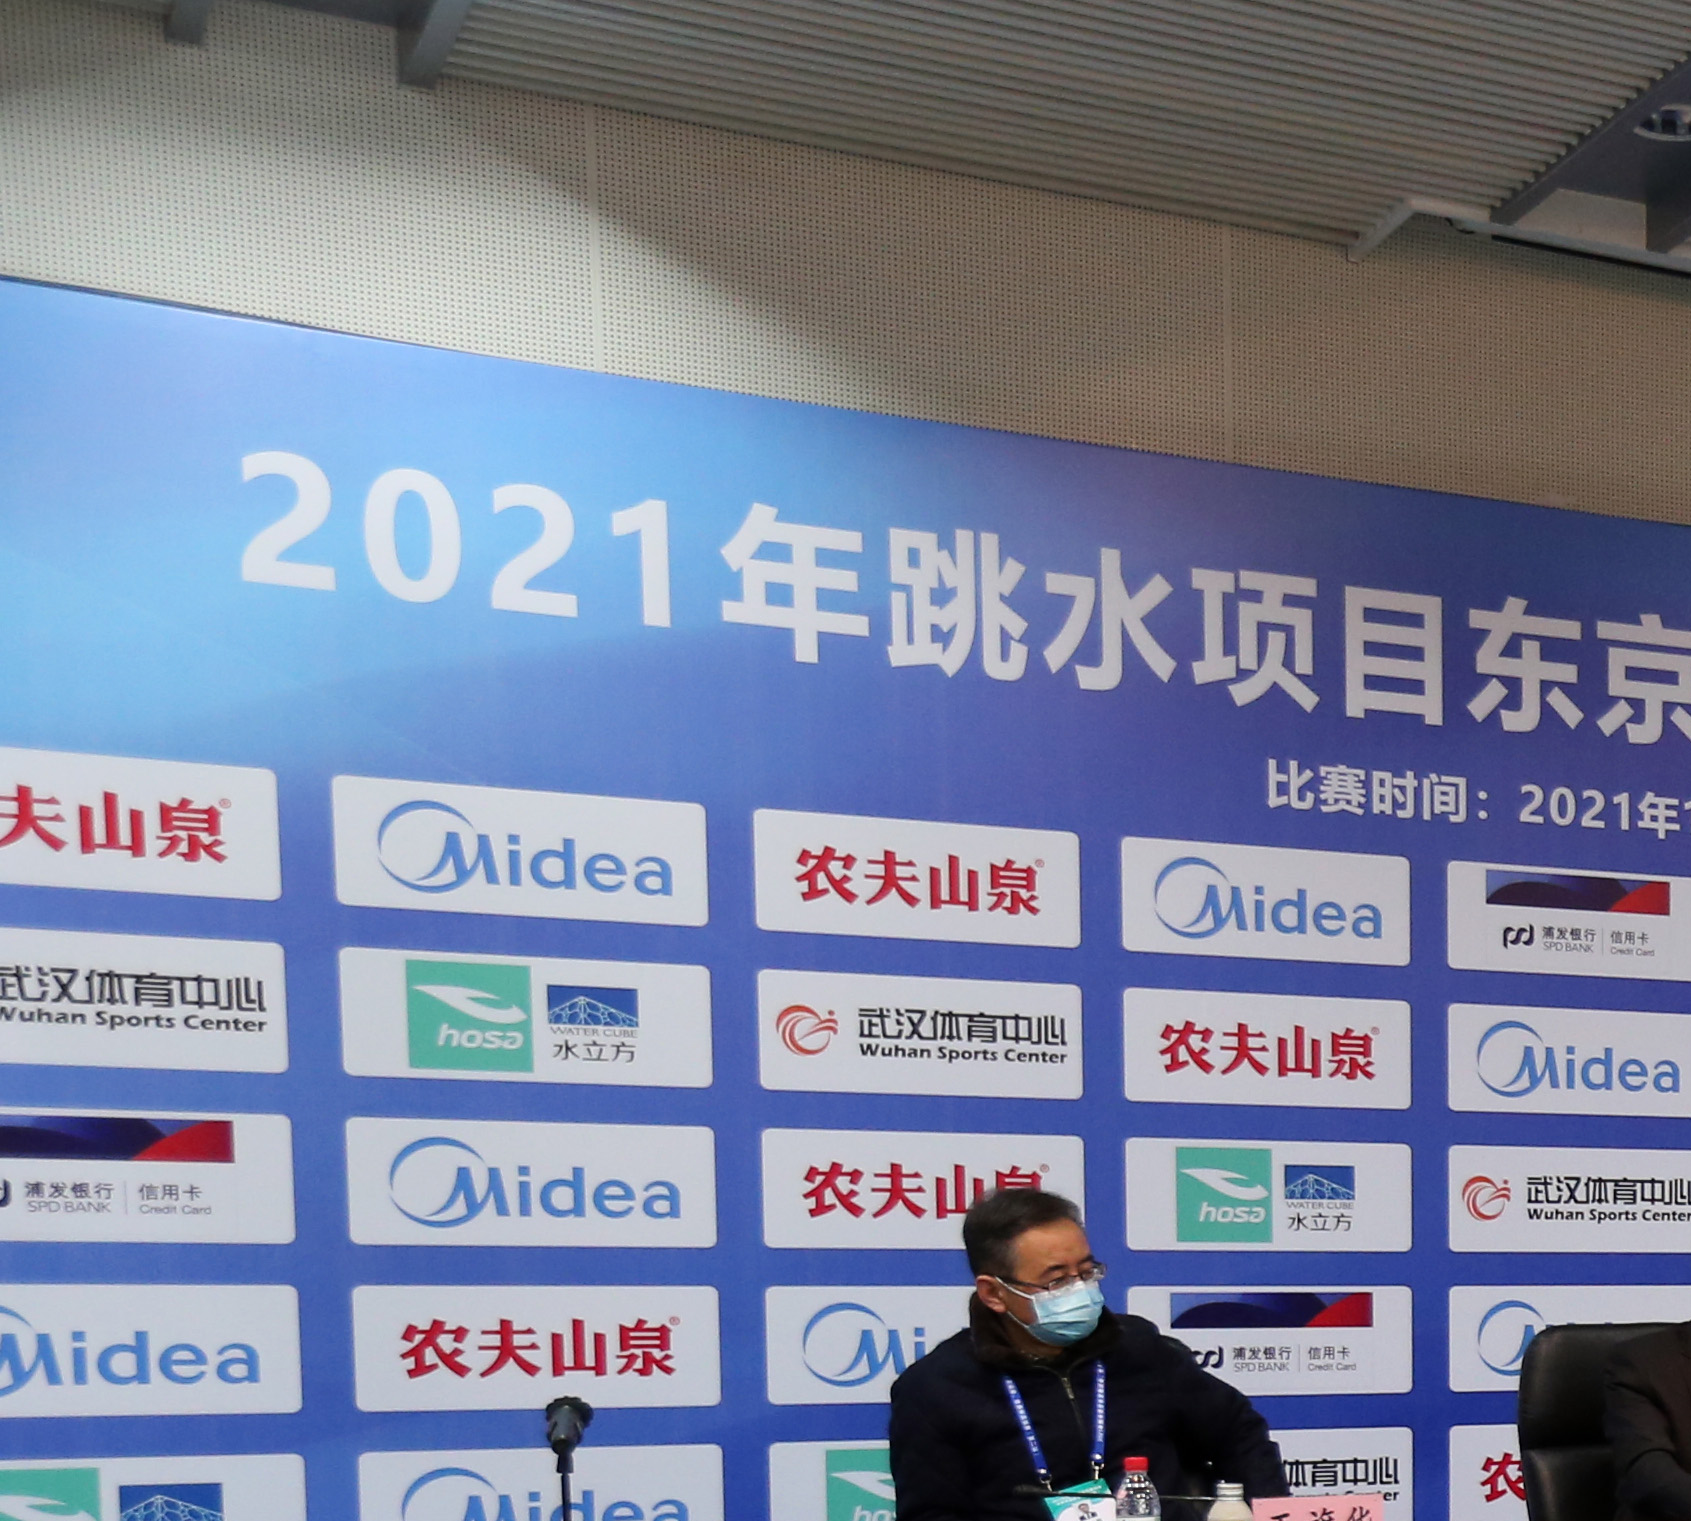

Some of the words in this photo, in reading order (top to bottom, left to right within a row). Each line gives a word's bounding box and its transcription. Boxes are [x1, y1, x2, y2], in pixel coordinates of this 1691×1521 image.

[377, 799, 674, 897] Midea
[795, 845, 1041, 917] 农夫山泉
[1154, 856, 1384, 939] Midea
[1542, 926, 1597, 943] 浦发银行
[1611, 931, 1650, 946] 信用卡
[1543, 941, 1563, 951] SPD
[1565, 943, 1594, 953] BANK
[0, 965, 267, 1012] 武汉体育中心
[95, 1010, 176, 1031] Sports
[184, 1014, 268, 1032] Center
[858, 1007, 1068, 1048] 武汉体育中心
[437, 1022, 525, 1051] hosa
[550, 1026, 607, 1037] WATER
[609, 1028, 639, 1039] CUBE
[553, 1039, 637, 1064] 水立方
[859, 1043, 932, 1062] Wuhan
[937, 1046, 999, 1065] Sports
[1004, 1048, 1068, 1065] Center
[1159, 1020, 1376, 1082] 农夫山泉
[1476, 1020, 1681, 1098] Midea
[24, 1180, 115, 1200] 浦发银行
[139, 1183, 203, 1202] 信用卡
[388, 1136, 681, 1229] Midea
[28, 1201, 60, 1213] SPD
[64, 1201, 112, 1213] BANK
[139, 1204, 177, 1215] Credit
[181, 1204, 212, 1215] Card
[1199, 1202, 1267, 1223] hosa
[1527, 1207, 1585, 1222] Wuhan
[1589, 1207, 1638, 1224] Sports
[1288, 1212, 1353, 1232] 水立方
[400, 1317, 676, 1380] 农夫山泉
[1232, 1346, 1292, 1360] 浦发银行
[1308, 1346, 1351, 1361] 信用卡
[1234, 1362, 1257, 1372] SPD
[1258, 1362, 1290, 1372] BANK
[1283, 1456, 1400, 1488] 体育中心
